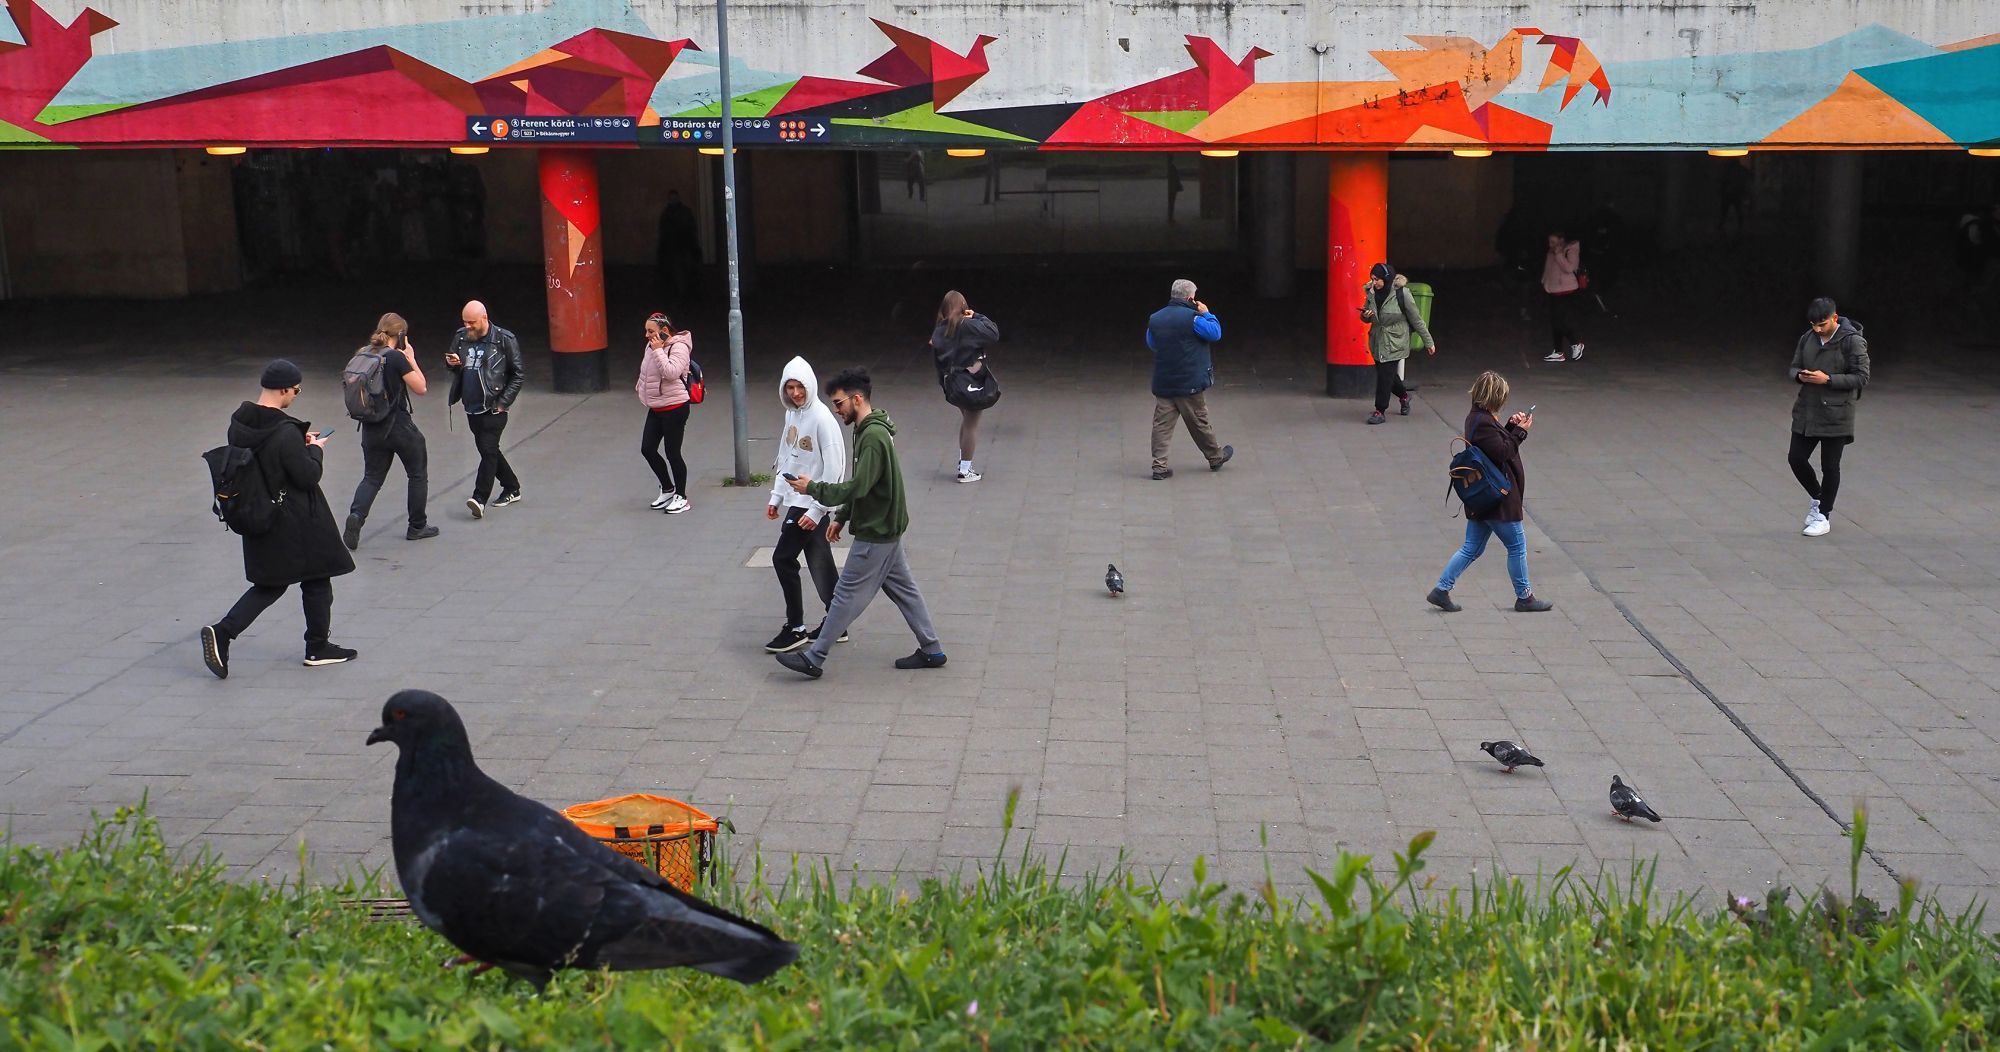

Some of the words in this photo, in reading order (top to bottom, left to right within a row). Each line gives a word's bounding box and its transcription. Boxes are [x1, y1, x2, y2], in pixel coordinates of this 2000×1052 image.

[520, 119, 549, 128] Ferenc
[672, 120, 706, 128] Boráros
[707, 120, 721, 128] tér
